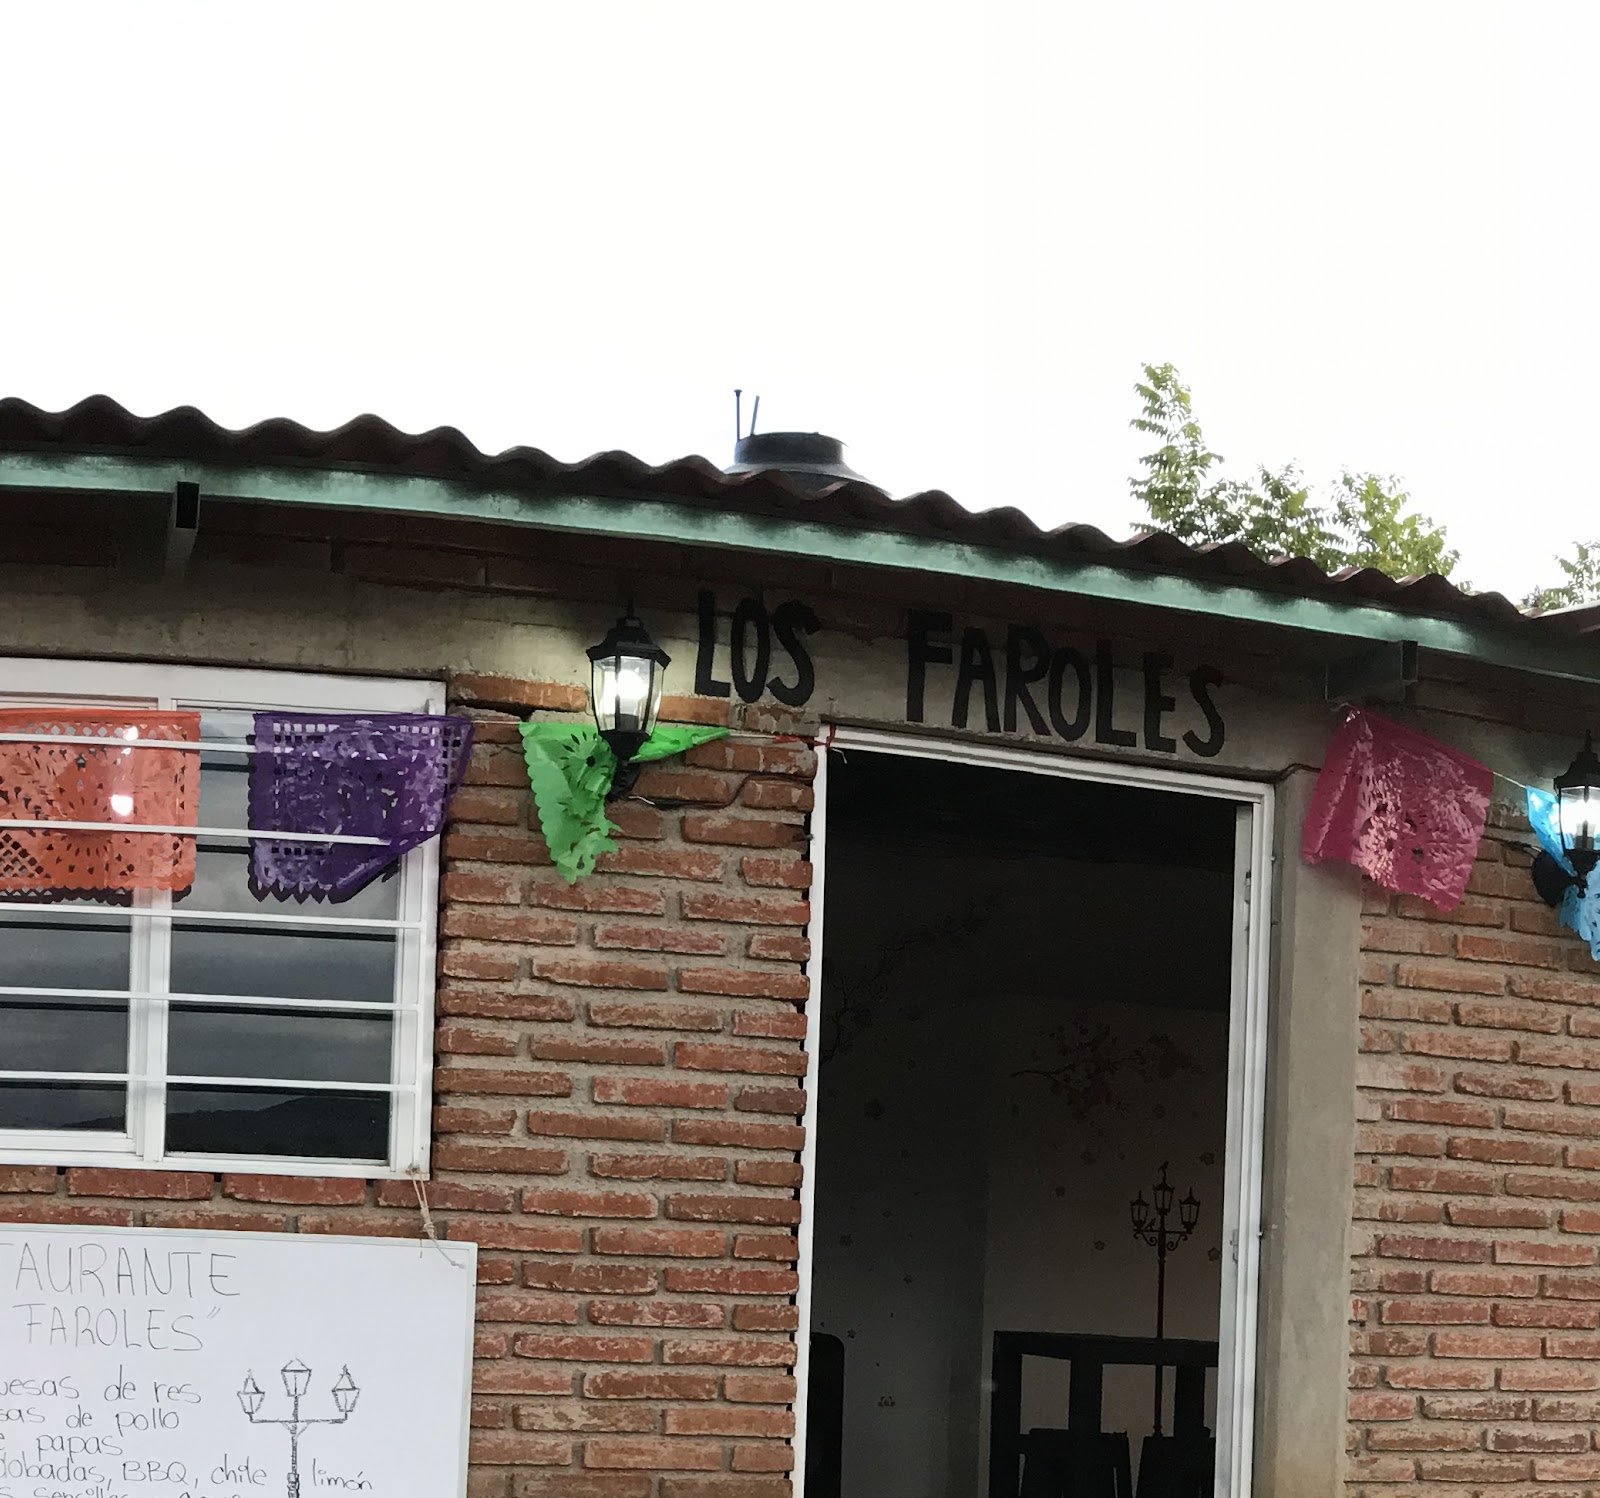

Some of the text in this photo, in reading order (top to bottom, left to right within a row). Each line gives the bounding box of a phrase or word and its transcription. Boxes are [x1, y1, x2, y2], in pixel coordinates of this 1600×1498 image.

[695, 590, 1226, 758] LOS FAROLES
[103, 1364, 137, 1402] de
[153, 1381, 202, 1403] res
[65, 1404, 93, 1429] de
[115, 1407, 180, 1437] pollo
[35, 1433, 123, 1463] papas
[122, 1460, 199, 1489] BBQ,
[210, 1453, 268, 1487] chile
[312, 1457, 374, 1491] limón
